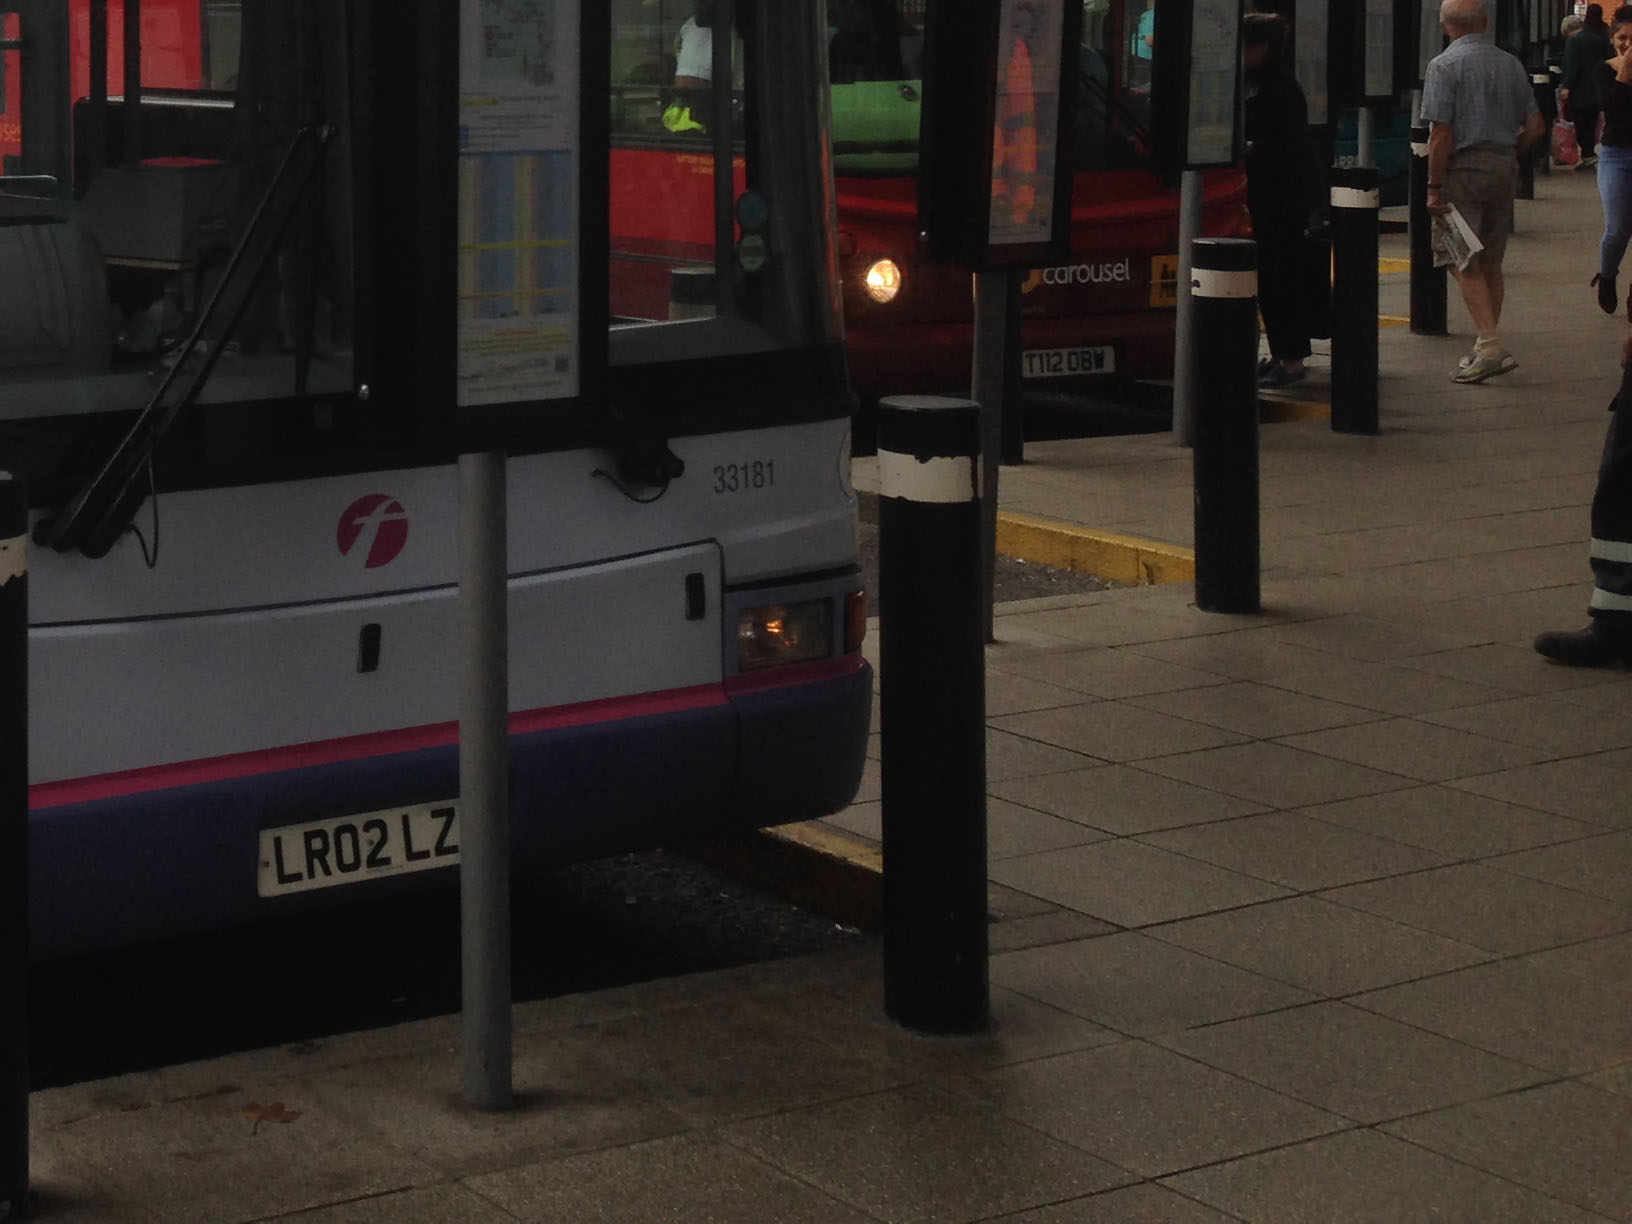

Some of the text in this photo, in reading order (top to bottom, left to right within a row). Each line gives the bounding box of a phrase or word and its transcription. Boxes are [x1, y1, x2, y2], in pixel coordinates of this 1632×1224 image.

[1043, 258, 1130, 284] carousel
[1025, 352, 1064, 374] T112
[713, 458, 774, 494] 33181
[273, 807, 460, 885] LR02 LZ
